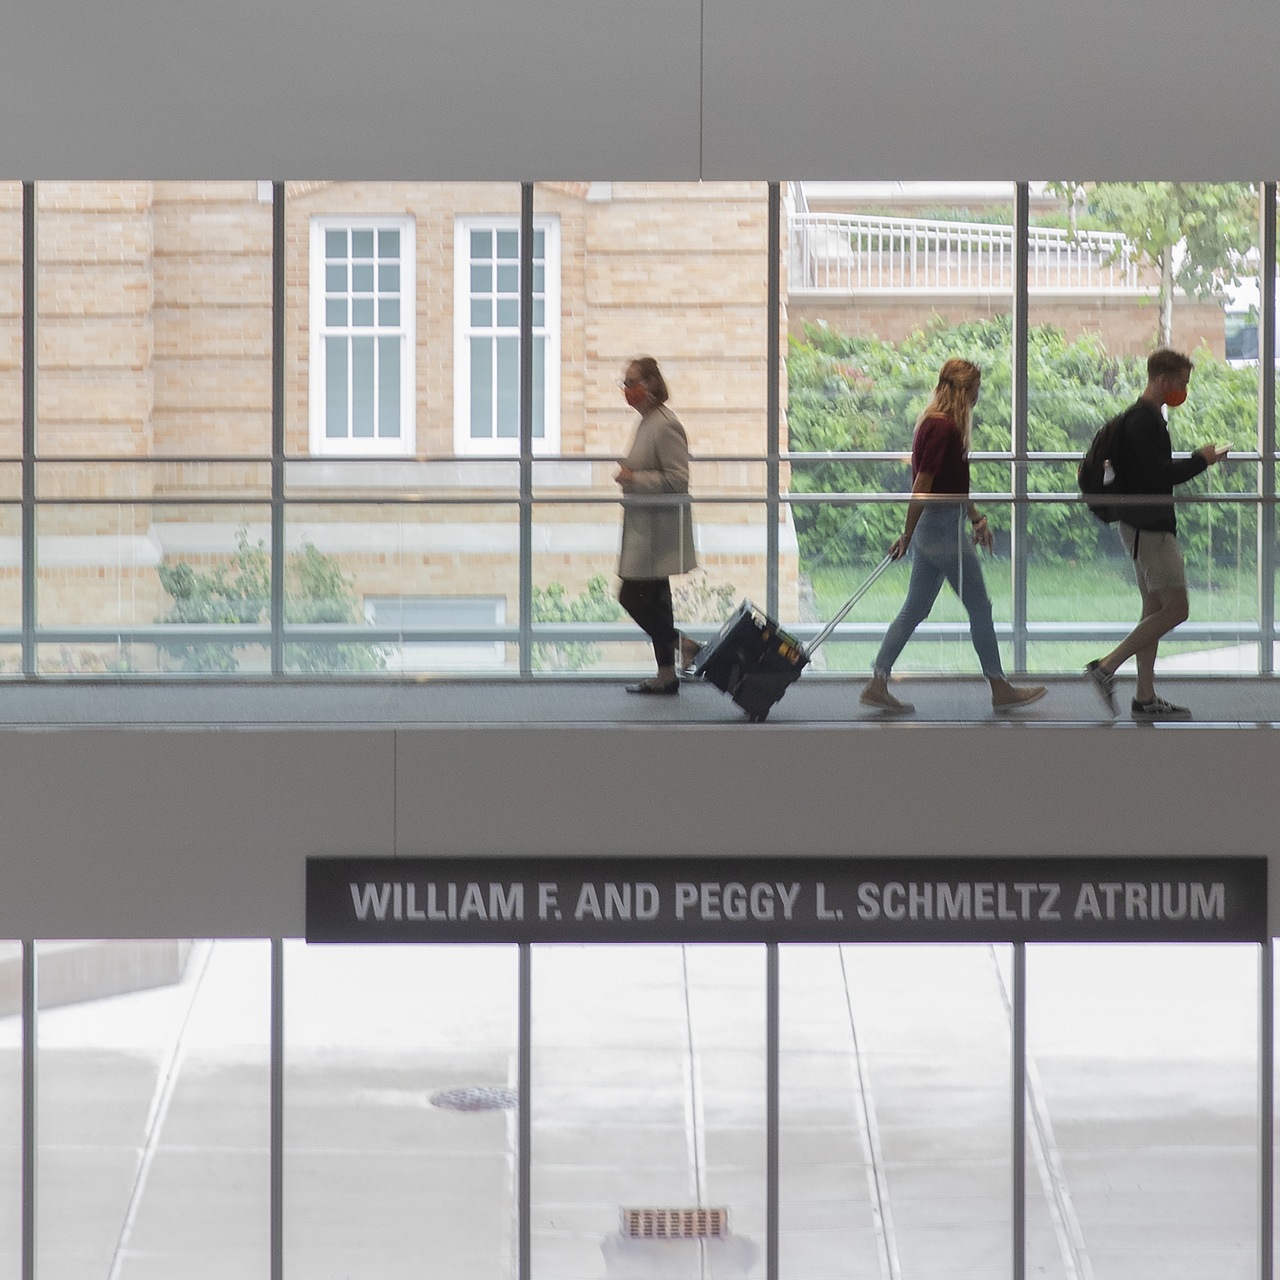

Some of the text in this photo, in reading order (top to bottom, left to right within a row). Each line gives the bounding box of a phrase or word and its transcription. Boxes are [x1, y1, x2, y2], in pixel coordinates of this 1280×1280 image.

[349, 881, 1226, 921] WILLIAM F. AND PEGGY L. SCHMELTZ ATRIUM
